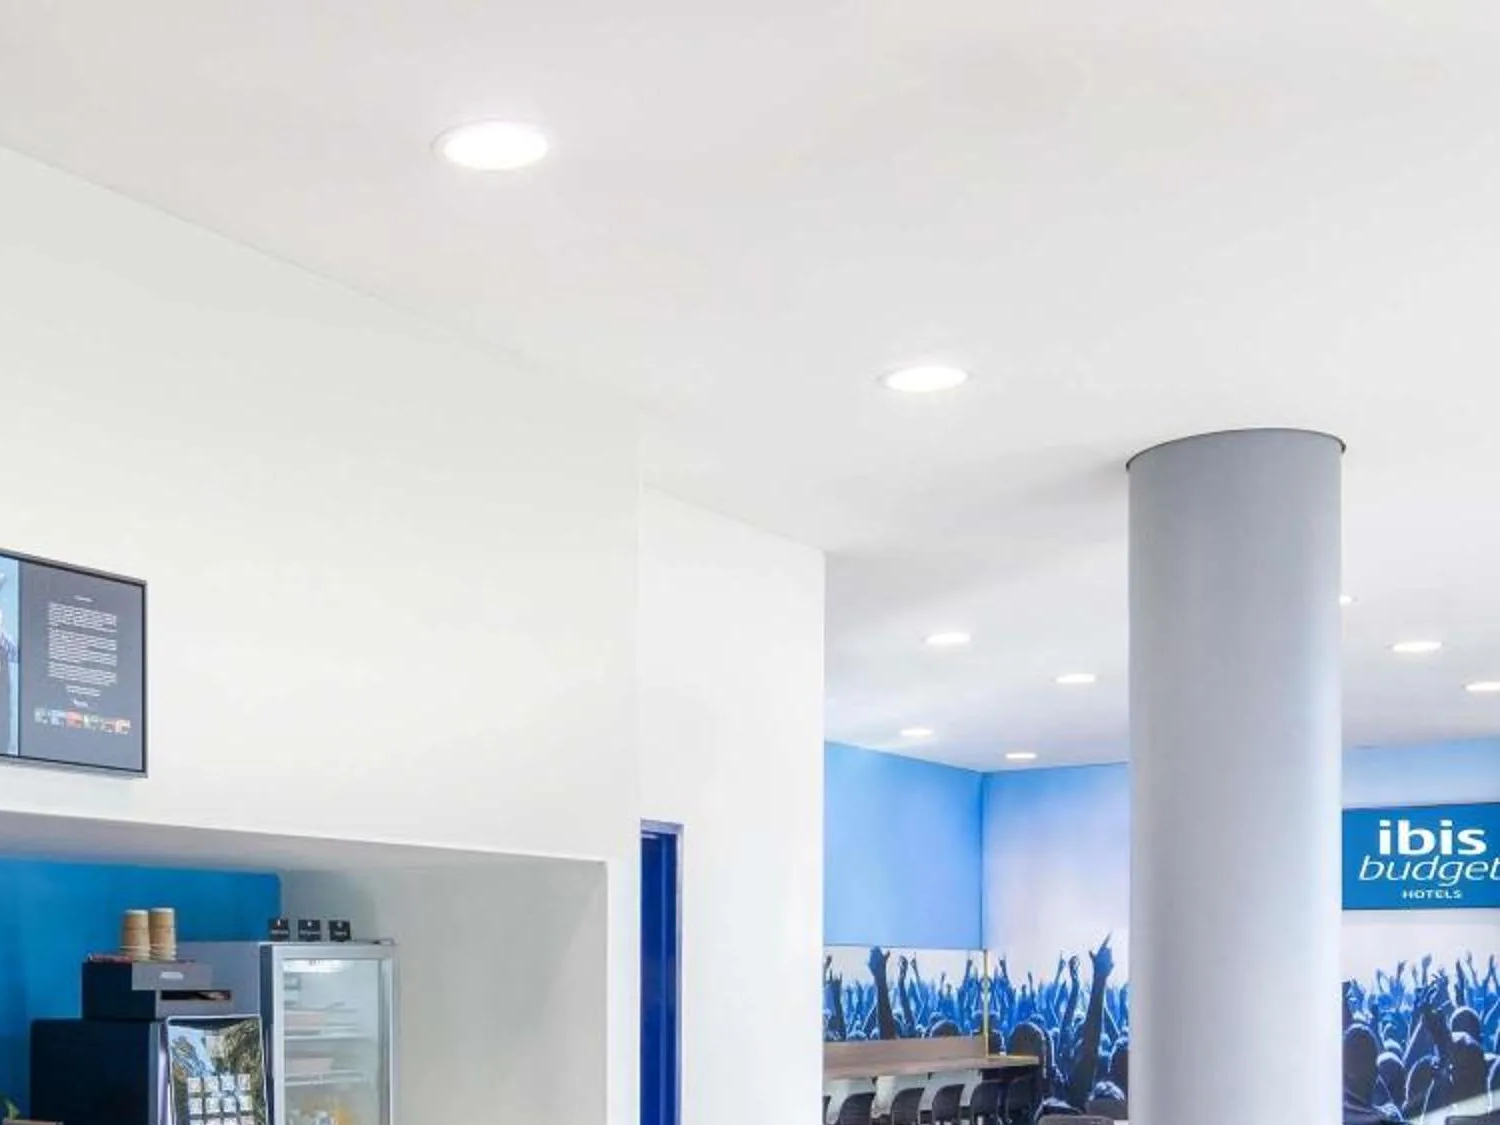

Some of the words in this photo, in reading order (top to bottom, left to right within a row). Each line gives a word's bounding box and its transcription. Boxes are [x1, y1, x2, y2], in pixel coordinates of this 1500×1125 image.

[1379, 819, 1487, 856] ibis
[1358, 854, 1500, 887] budget
[1402, 889, 1463, 899] HOTELS
